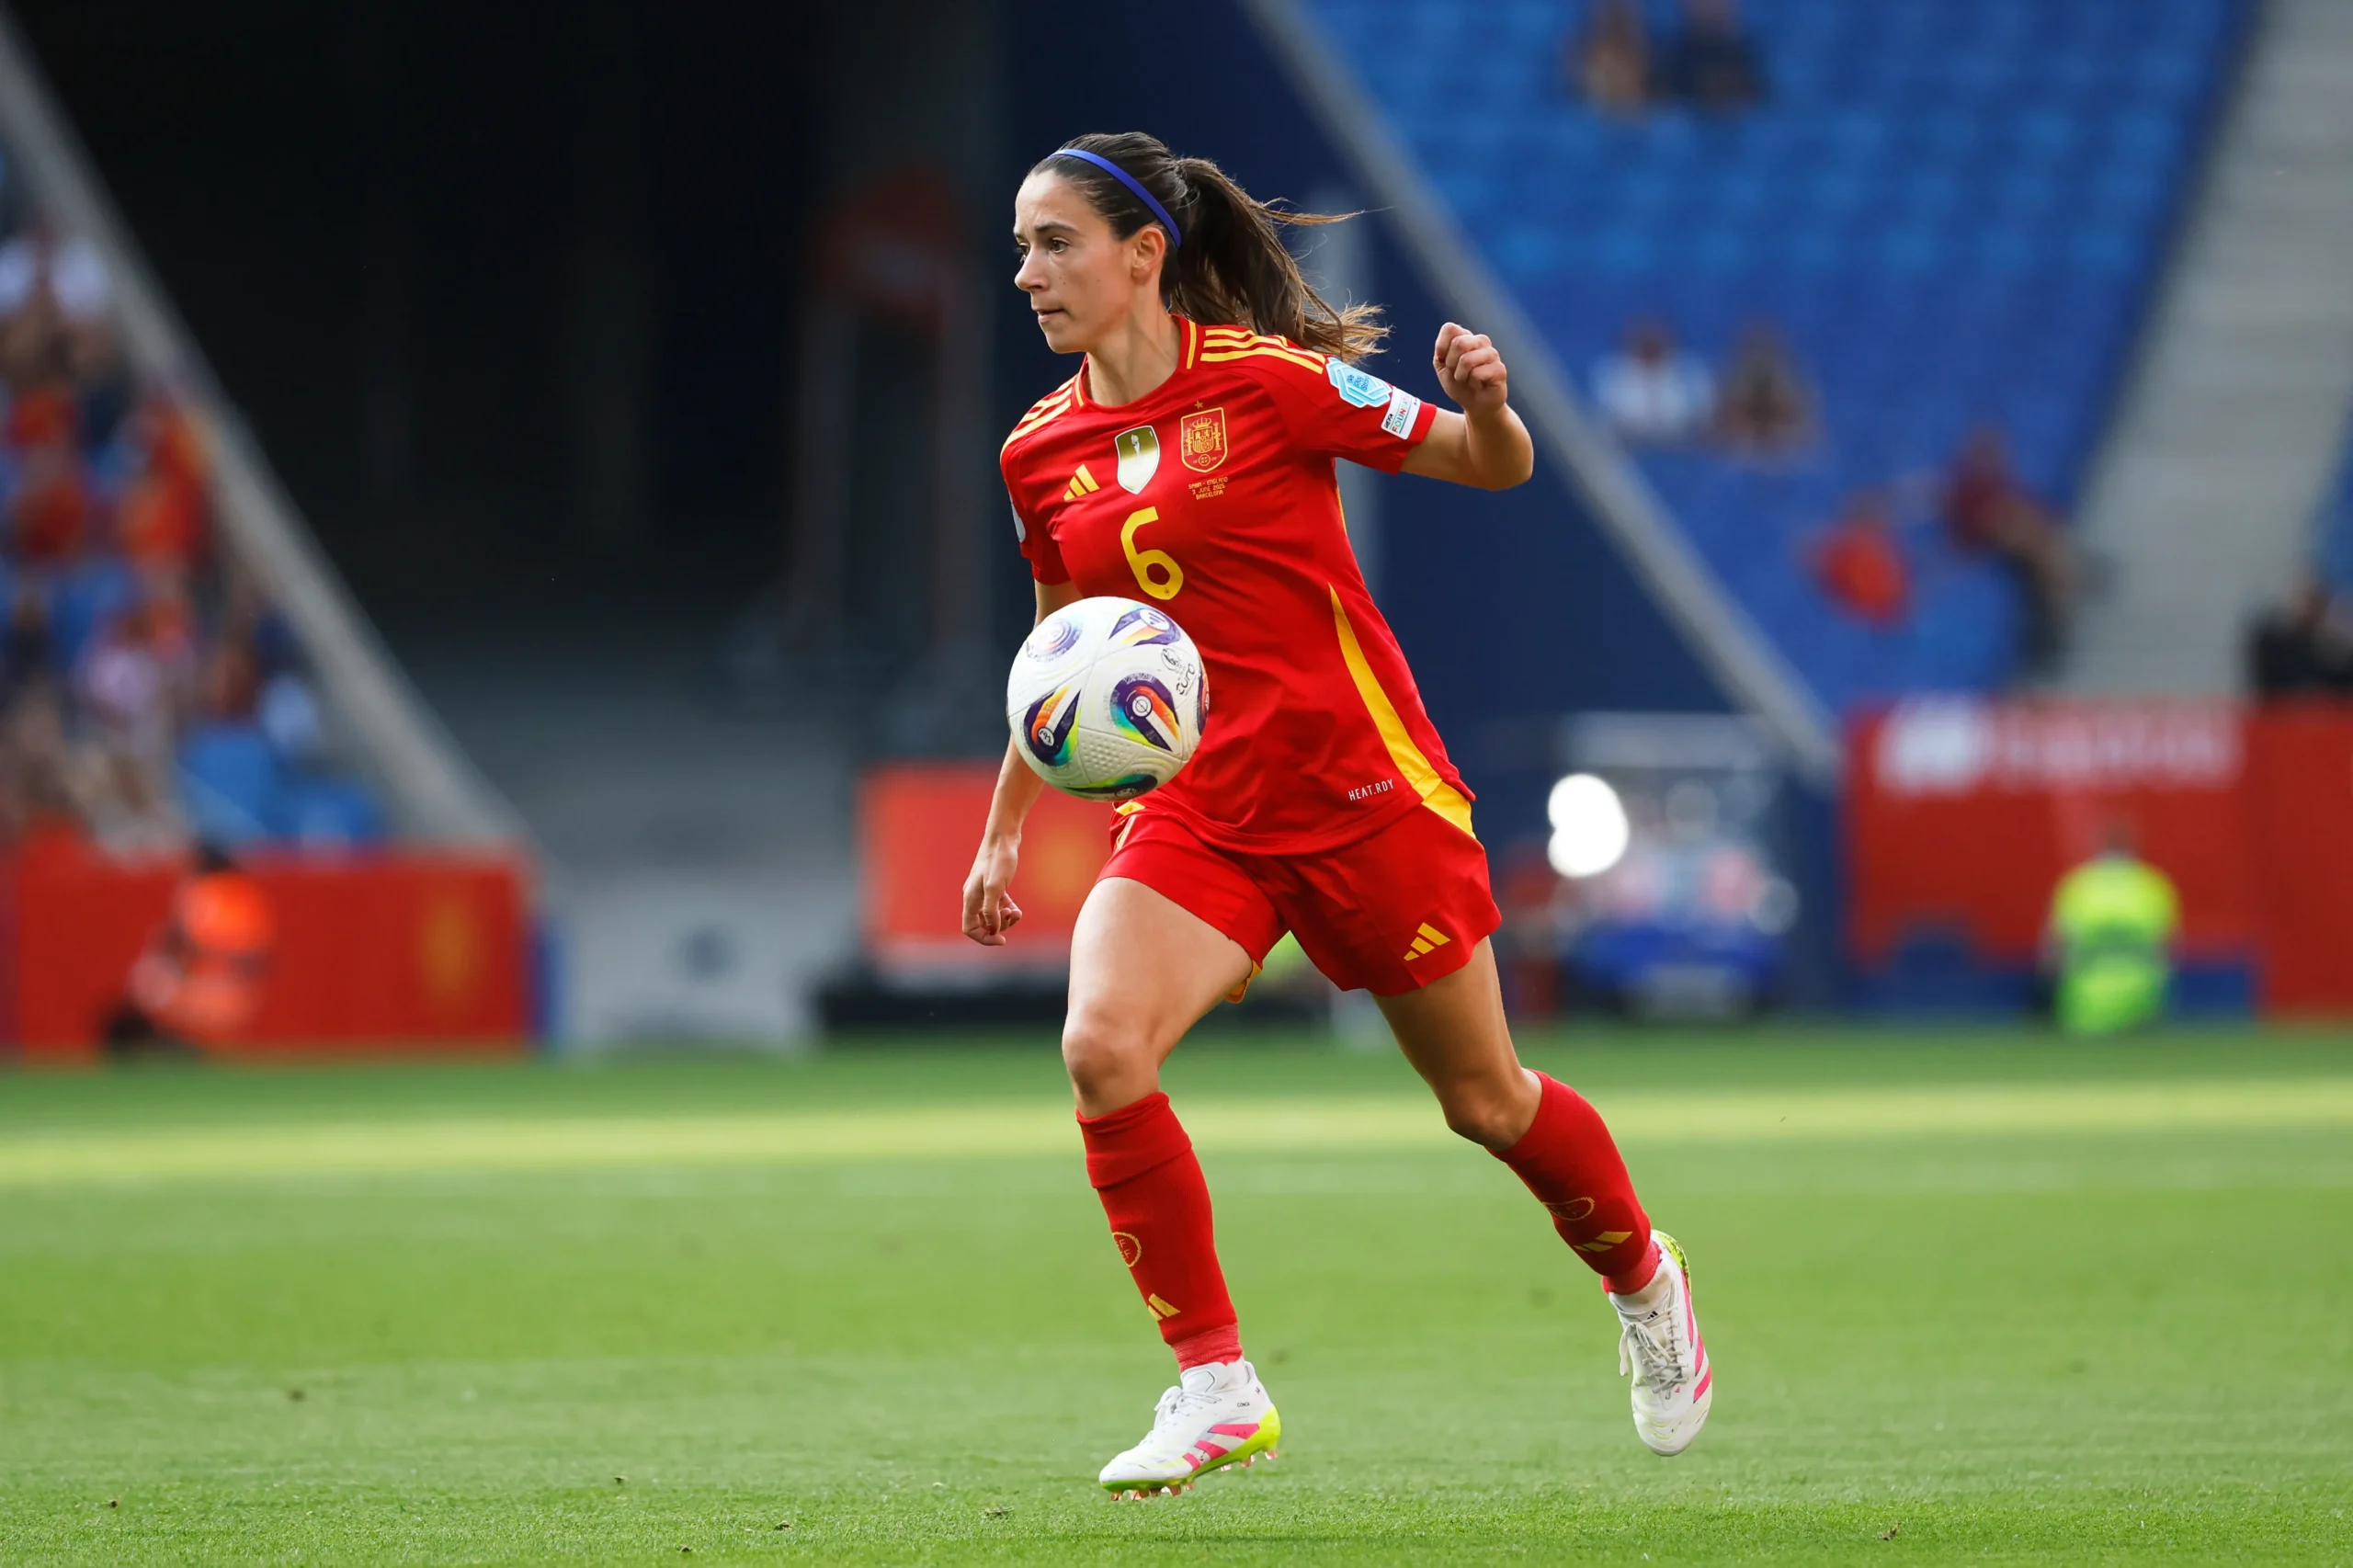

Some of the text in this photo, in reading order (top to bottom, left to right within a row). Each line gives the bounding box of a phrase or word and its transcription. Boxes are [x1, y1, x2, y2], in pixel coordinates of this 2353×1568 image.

[1383, 413, 1394, 428] UEFA
[1188, 482, 1202, 490] SPAIN
[1206, 476, 1229, 485] ENGLAND
[1195, 489, 1224, 501] BARCELONA
[1120, 506, 1184, 600] 6
